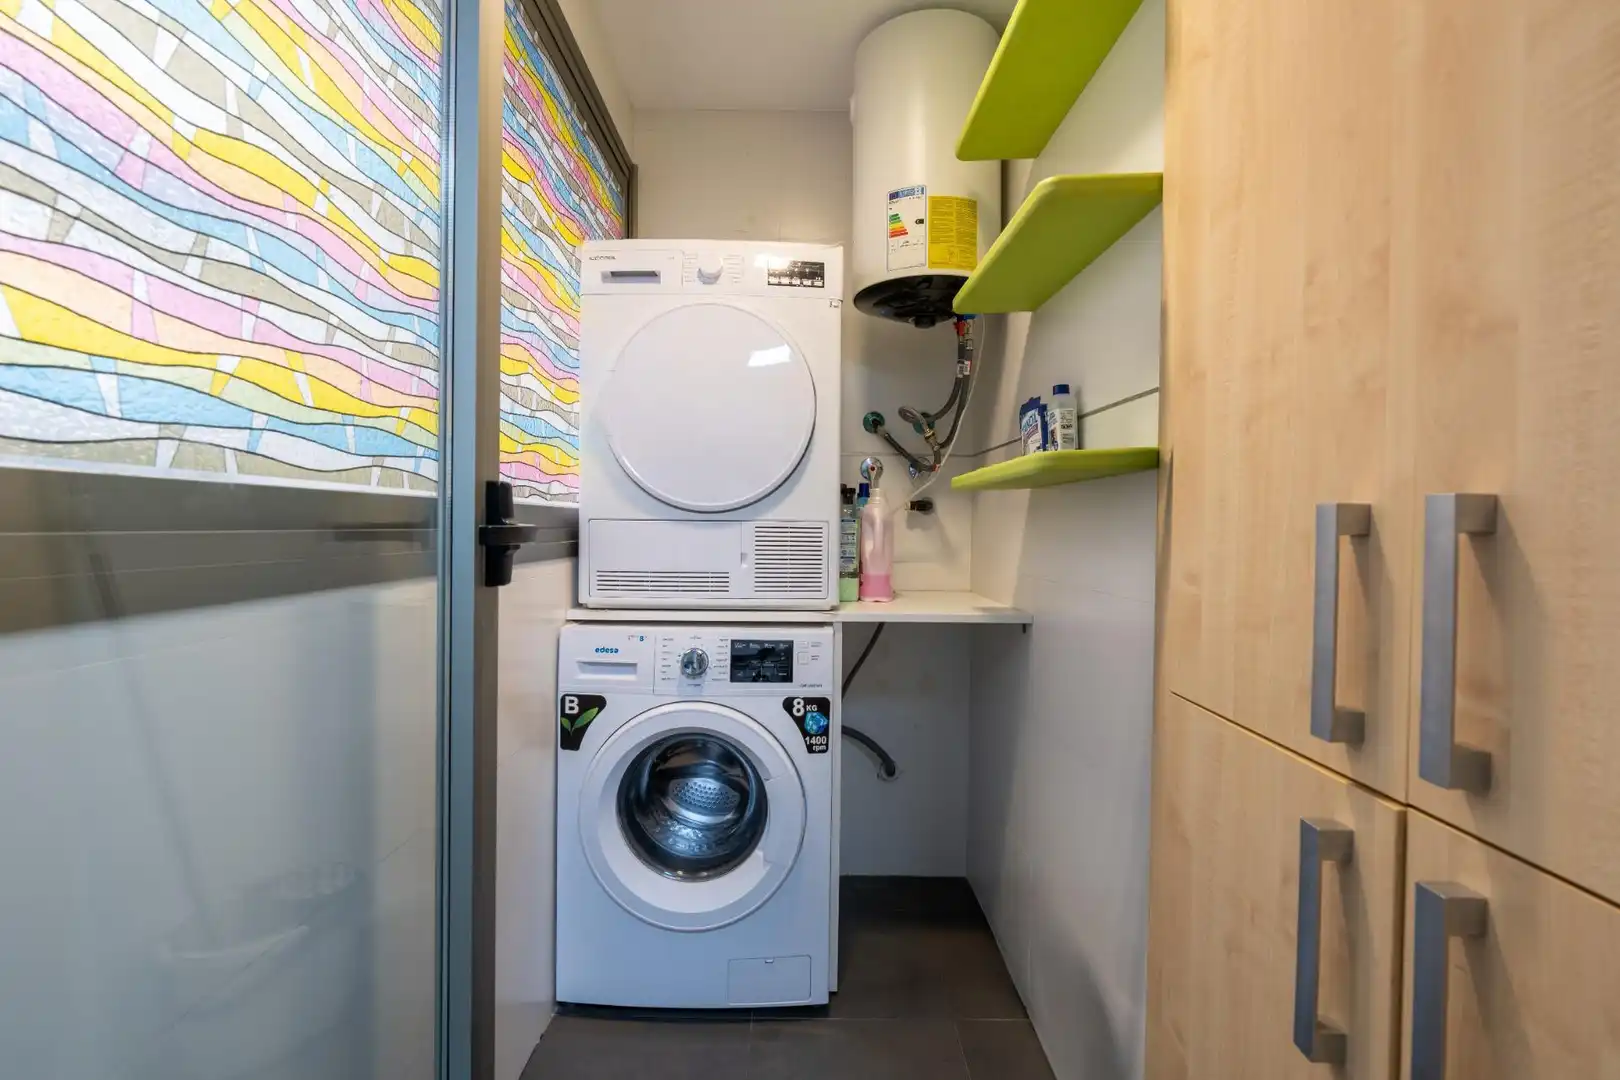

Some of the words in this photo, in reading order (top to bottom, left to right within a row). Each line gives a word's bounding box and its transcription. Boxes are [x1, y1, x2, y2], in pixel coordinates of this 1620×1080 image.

[594, 646, 619, 654] edesa
[564, 696, 579, 714] B
[792, 698, 805, 717] 8
[805, 736, 827, 745] 1400
